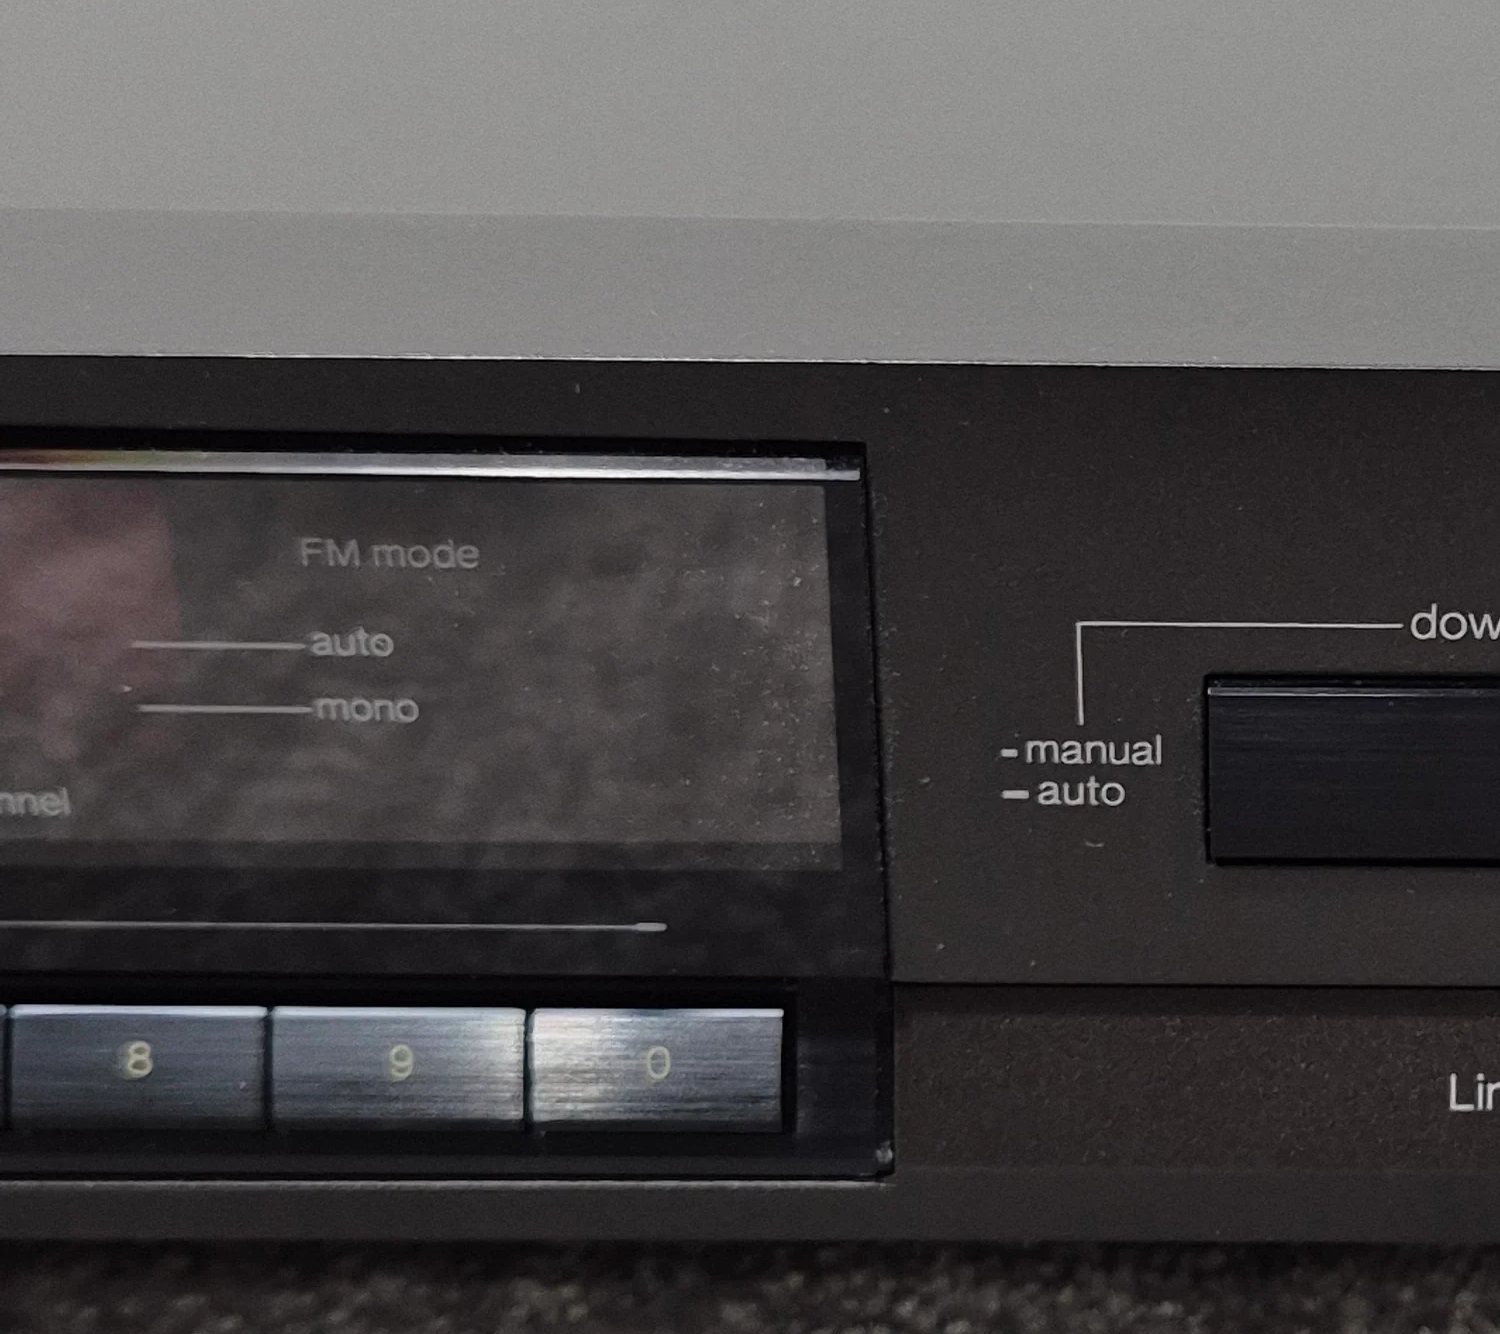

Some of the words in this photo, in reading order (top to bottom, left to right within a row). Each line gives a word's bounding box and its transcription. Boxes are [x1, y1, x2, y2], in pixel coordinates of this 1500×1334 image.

[301, 538, 361, 568] FM
[373, 539, 480, 569] mode
[311, 627, 394, 658] auto
[315, 696, 419, 723] mono
[1026, 734, 1162, 766] manual
[1038, 774, 1125, 807] auto
[122, 1040, 153, 1079] 8
[389, 1045, 414, 1080] 9
[645, 1047, 671, 1079] 0
